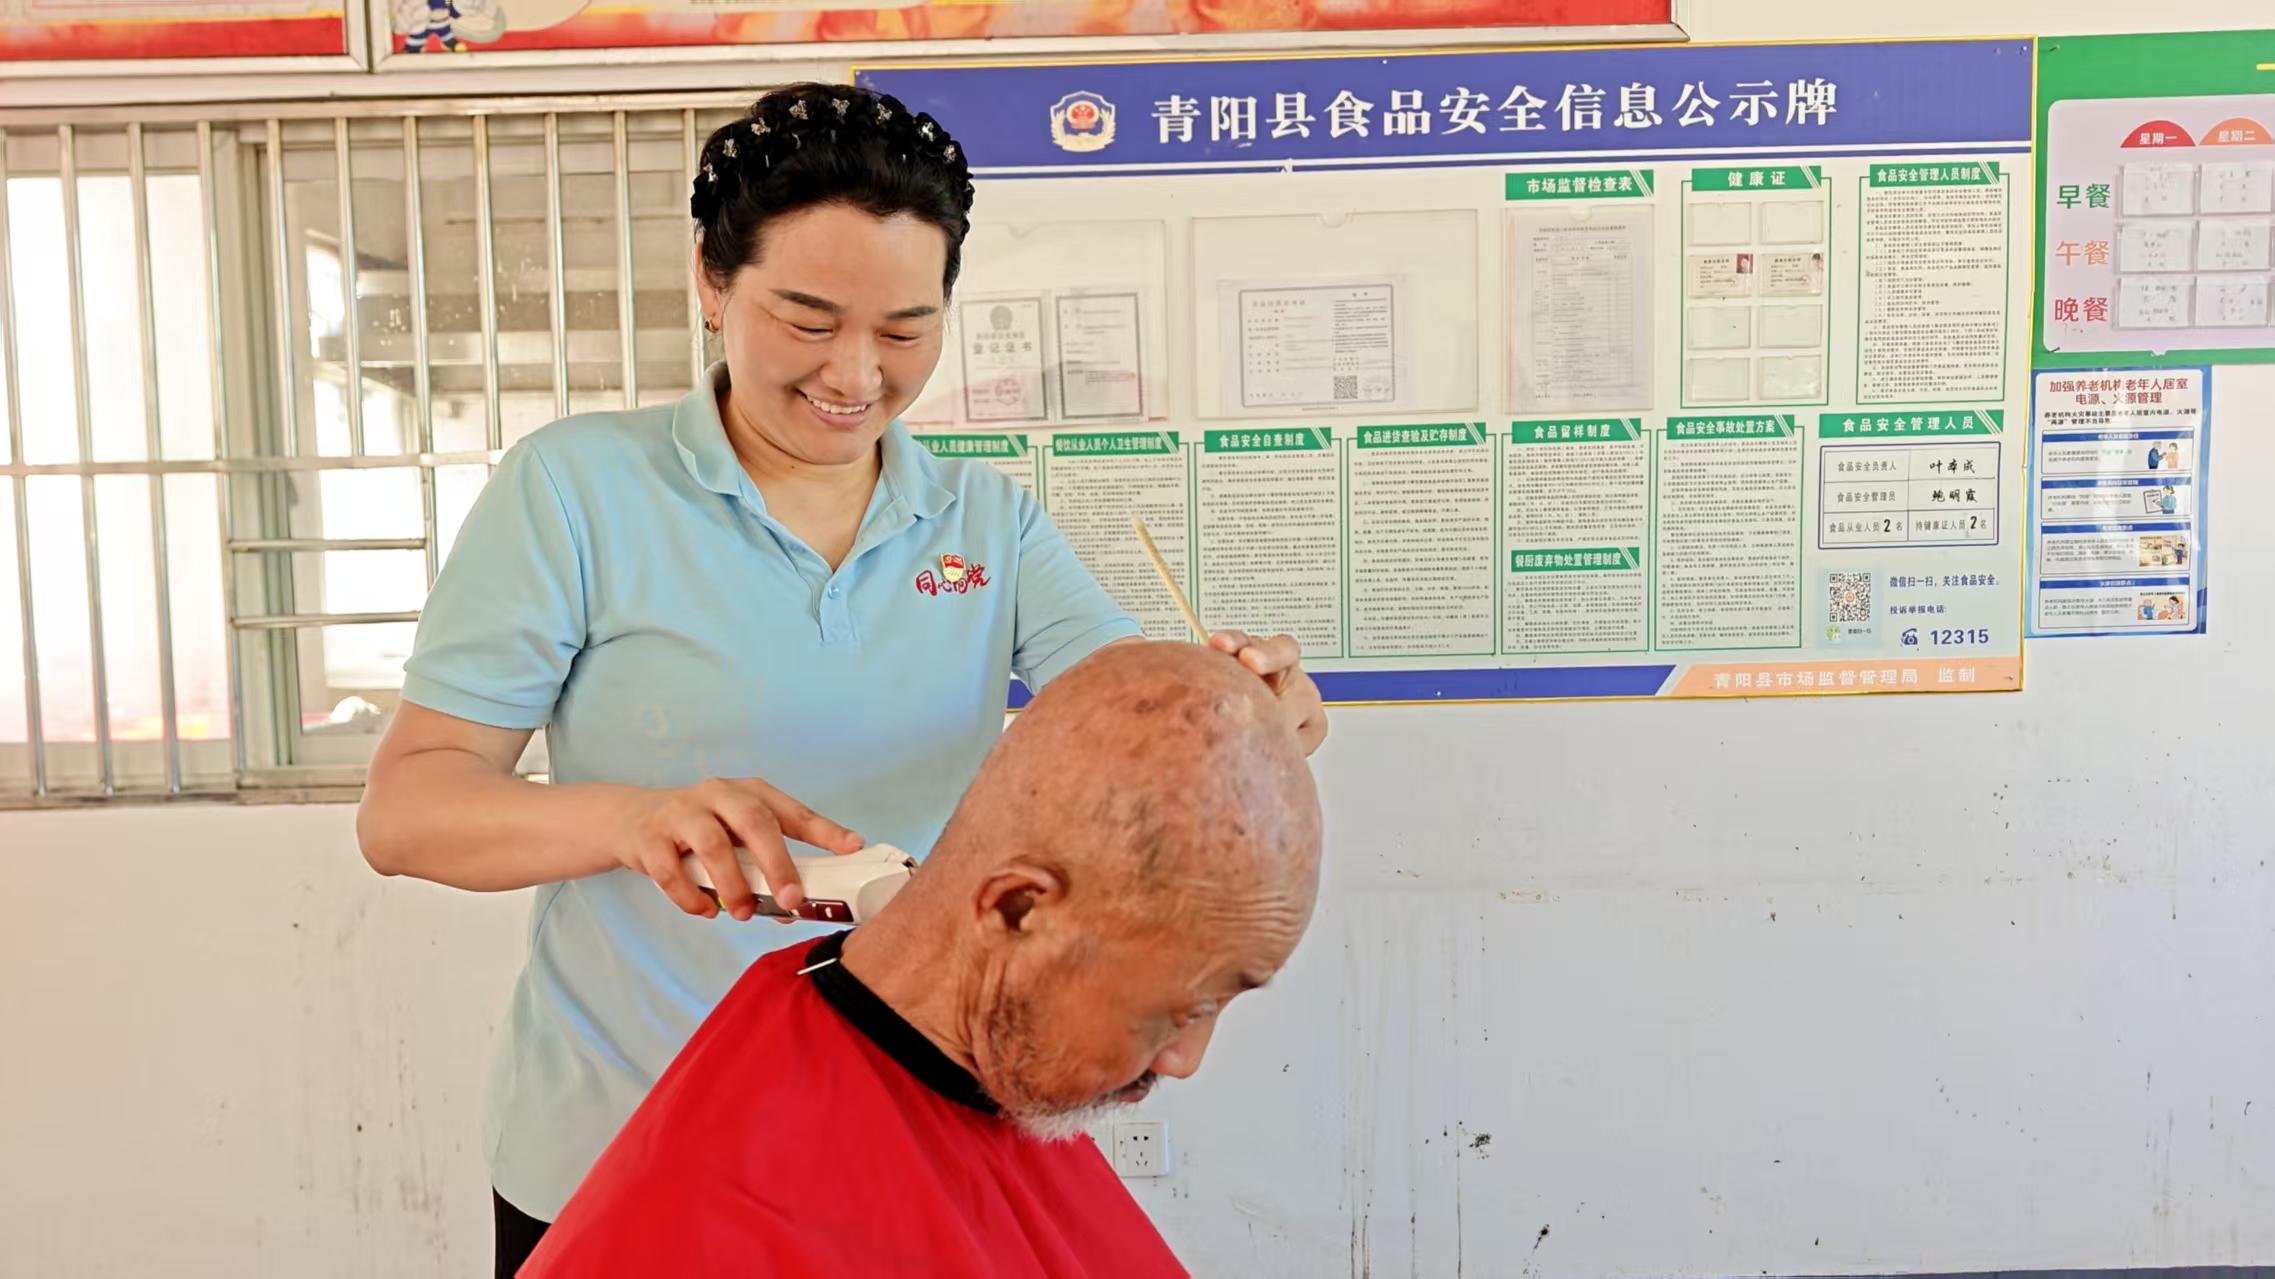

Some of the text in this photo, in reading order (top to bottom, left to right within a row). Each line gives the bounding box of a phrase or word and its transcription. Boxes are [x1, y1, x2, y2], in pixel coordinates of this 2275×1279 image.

[1151, 78, 1838, 144] 青阳县食品安全信息公示牌
[2139, 132, 2177, 145] 星期一
[2218, 130, 2255, 142] 星期二
[1728, 171, 1785, 187] 健康证
[1877, 167, 1981, 182] 食品安全管理人员制度
[1526, 176, 1633, 194] 市场监督检查表
[2056, 184, 2111, 209] 早餐
[2055, 240, 2109, 266] 午餐
[2054, 297, 2108, 322] 晚餐
[1534, 424, 1611, 439] 食品留样制度
[1676, 420, 1776, 435] 食品安全事故处置方案
[1842, 415, 1975, 433] 食品安全管理人员
[1055, 436, 1162, 452] 餐饮从业人员个人卫生管理制度
[1218, 432, 1305, 448] 食品安全自查制度
[1363, 428, 1467, 444] 食品进货查验及贮存制度
[1838, 461, 1896, 472] 食品安全负责人
[1837, 491, 1896, 503] 食品安全管理员
[1829, 521, 1880, 533] 食品从业人员
[1883, 518, 1891, 533] 2
[1915, 519, 1966, 532] 持健康证人员
[1970, 515, 1977, 530] 2
[1515, 551, 1621, 569] 餐厨废弃物处置管理制度
[916, 563, 991, 597] 同心向党
[1930, 628, 1989, 645] 12315
[1714, 667, 1977, 689] 青阳县市场监督管理局 监制
